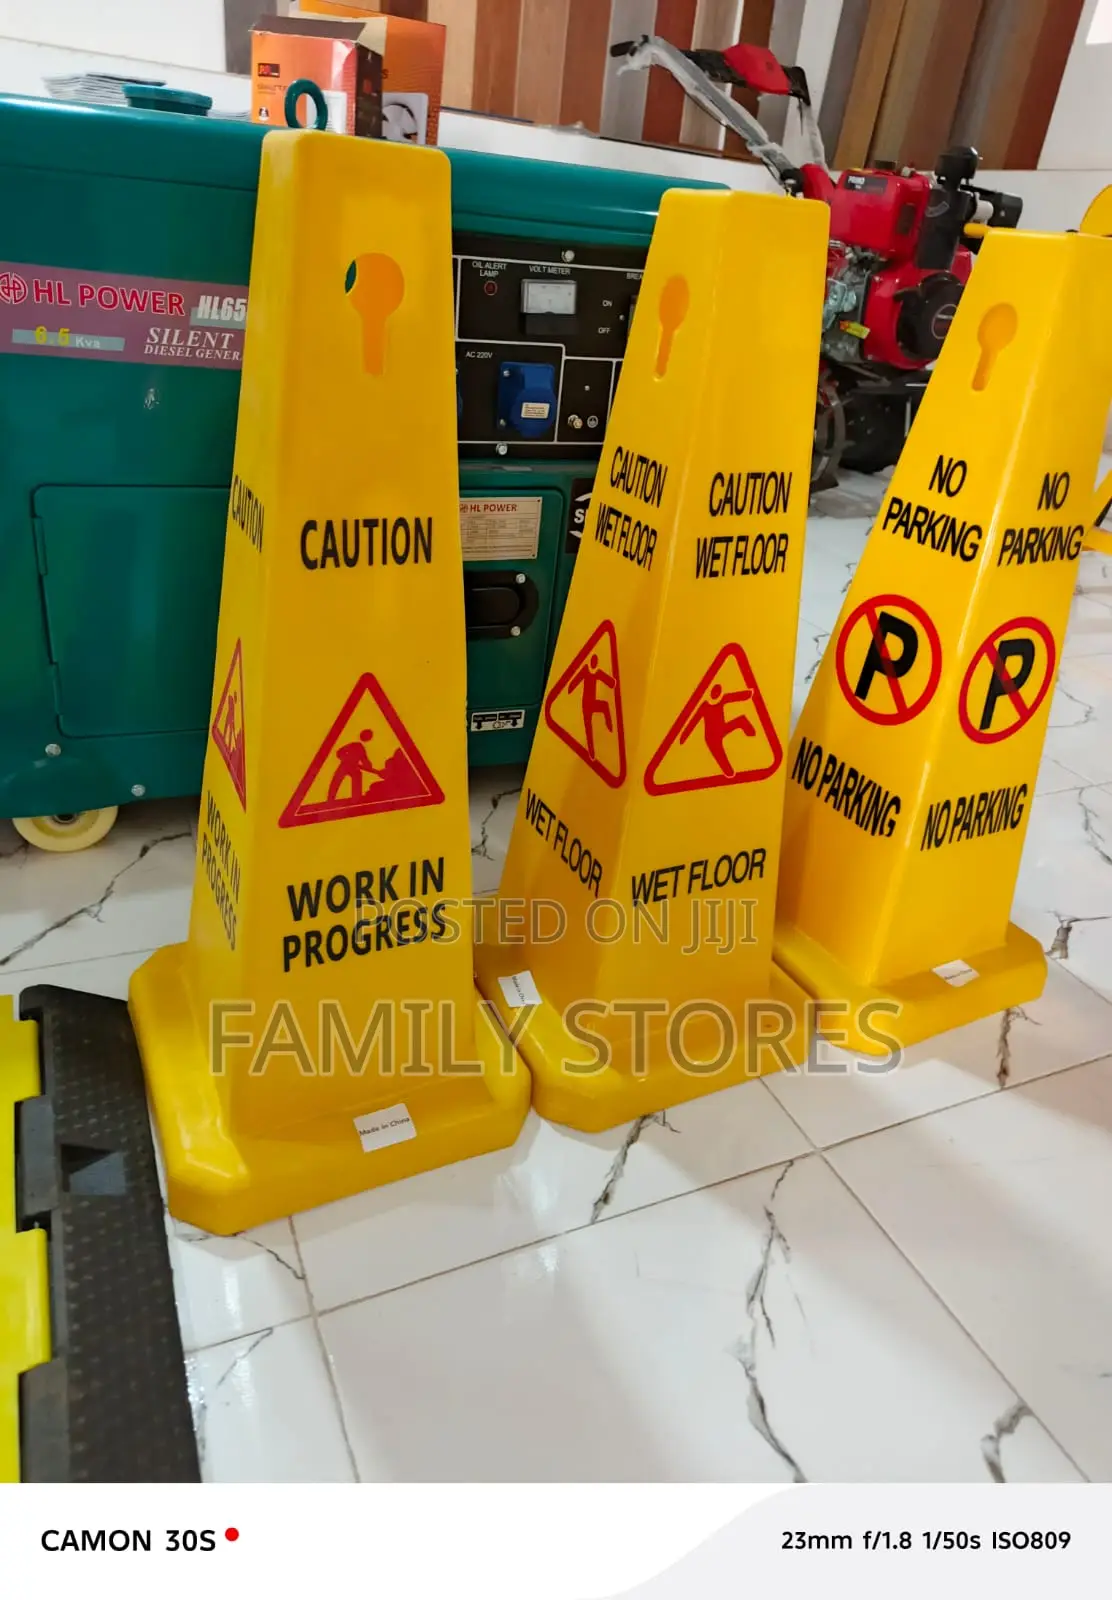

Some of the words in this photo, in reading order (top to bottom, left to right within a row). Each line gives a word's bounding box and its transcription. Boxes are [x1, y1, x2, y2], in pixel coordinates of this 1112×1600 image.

[472, 261, 484, 269] OIL
[485, 262, 507, 270] ALERT
[529, 265, 547, 273] VOLT
[549, 267, 571, 275] METER
[626, 272, 643, 280] BREA
[33, 278, 72, 305] HL
[78, 284, 185, 316] POWER
[144, 345, 193, 358] DIESEL
[195, 349, 243, 362] GENER
[146, 327, 235, 350] SILENT
[610, 446, 668, 508] CAUTION
[709, 472, 793, 517] CAUTION
[928, 455, 968, 498] NO
[1037, 471, 1070, 511] NO
[232, 475, 265, 553] CAUTION
[470, 504, 481, 512] HL
[484, 504, 517, 512] POWER
[882, 496, 983, 562] PARKING
[300, 517, 433, 570] CAUTION
[595, 502, 622, 550] WET
[617, 514, 658, 572] FLOOR
[696, 536, 734, 579] WET
[732, 533, 789, 576] FLOOR
[997, 524, 1084, 567] PARKING
[791, 736, 823, 791] NO
[816, 753, 901, 838] PARKING
[920, 799, 951, 852] NO
[948, 783, 1028, 844] PARKING
[207, 790, 232, 871] WORK
[230, 849, 241, 904] IN
[525, 788, 556, 842] WET
[553, 820, 603, 898] FLOOR
[202, 832, 237, 951] PROGRESS
[287, 865, 399, 922] WORK
[409, 857, 445, 897] IN
[631, 864, 685, 907] WET
[687, 848, 767, 894] FLOOR
[283, 903, 447, 973] PROGRESS
[359, 1126, 379, 1136] Made
[390, 1117, 410, 1127] China
